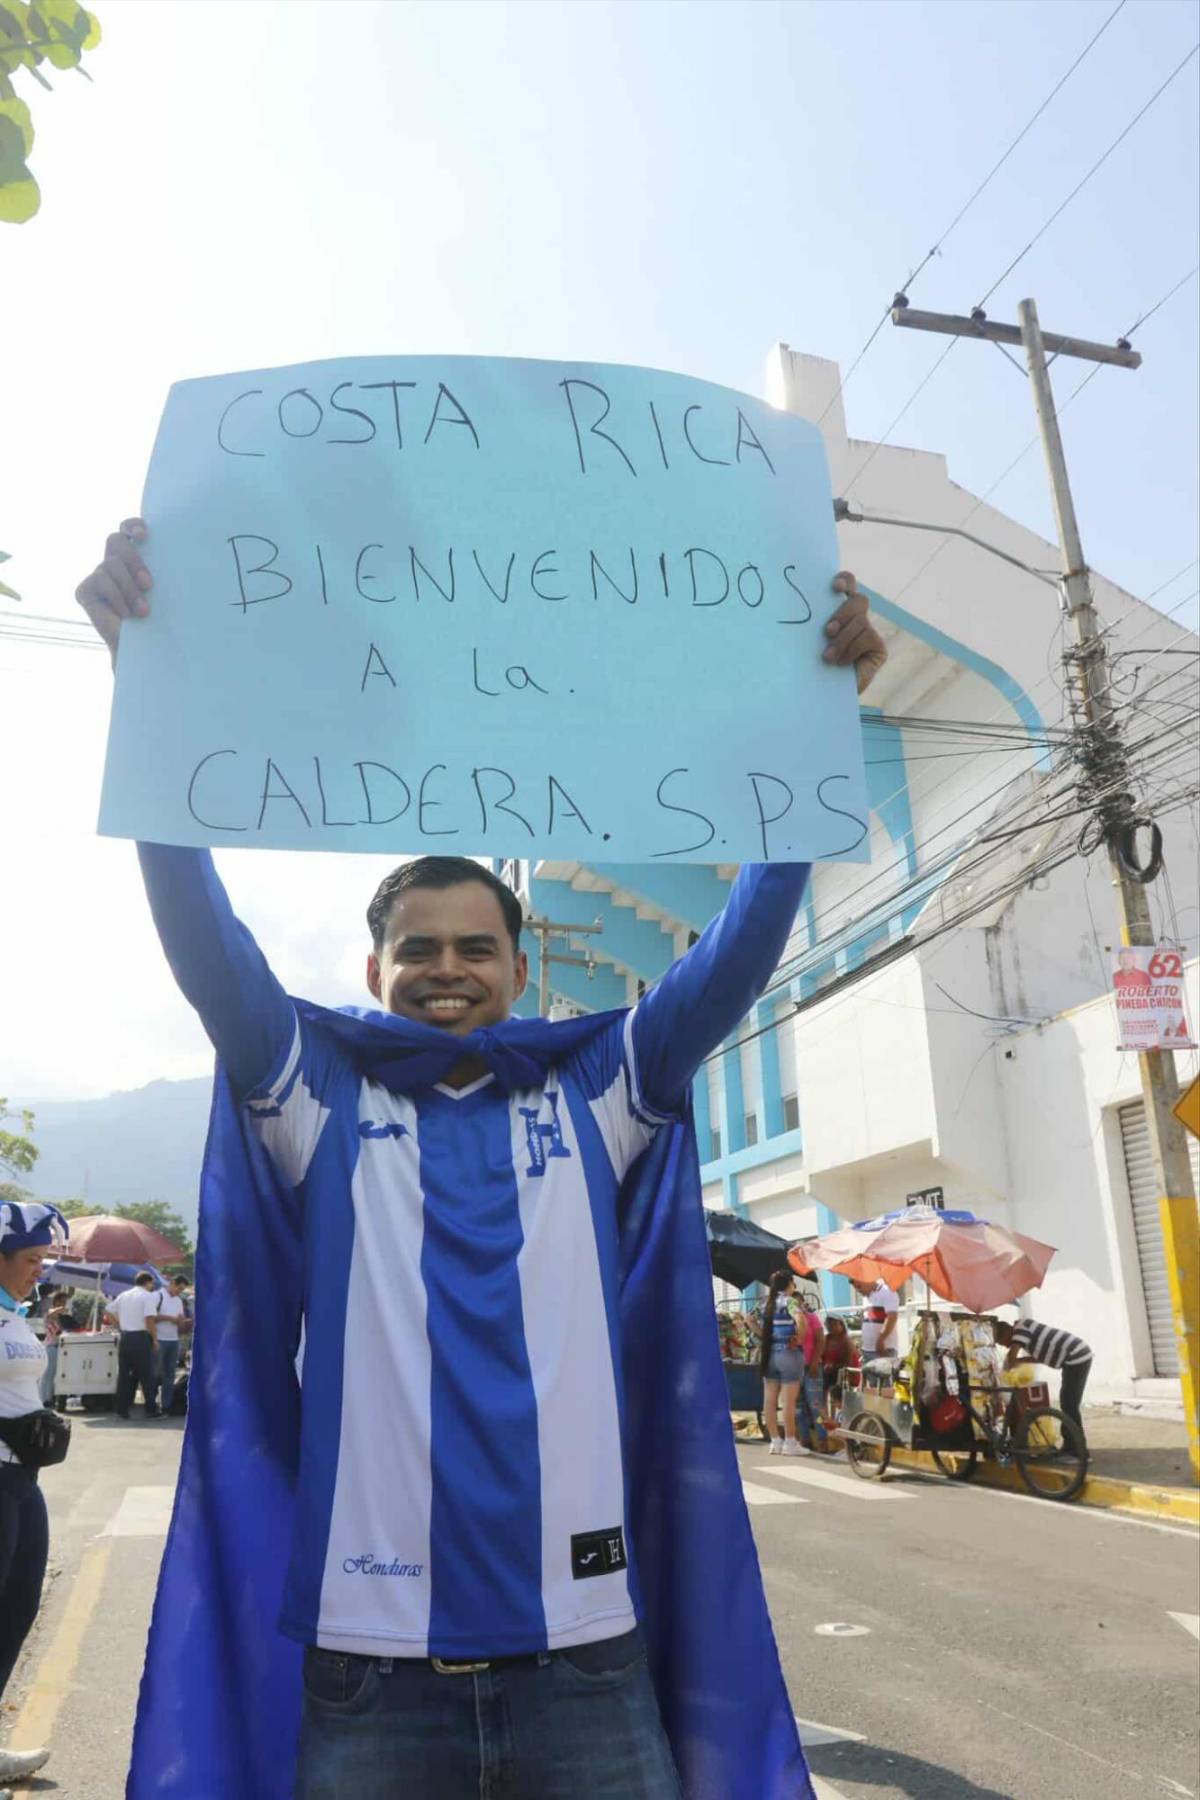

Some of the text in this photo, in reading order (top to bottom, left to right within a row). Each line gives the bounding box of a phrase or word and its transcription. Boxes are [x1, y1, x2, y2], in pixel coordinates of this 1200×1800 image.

[218, 378, 776, 477] COSTA RICA
[227, 534, 813, 624] BIENVENIDOS
[361, 643, 397, 693] A
[187, 749, 612, 843] CALDERA.
[1149, 953, 1184, 978] 62
[1118, 985, 1178, 997] ROBERTO
[342, 1553, 423, 1578] Honduras
